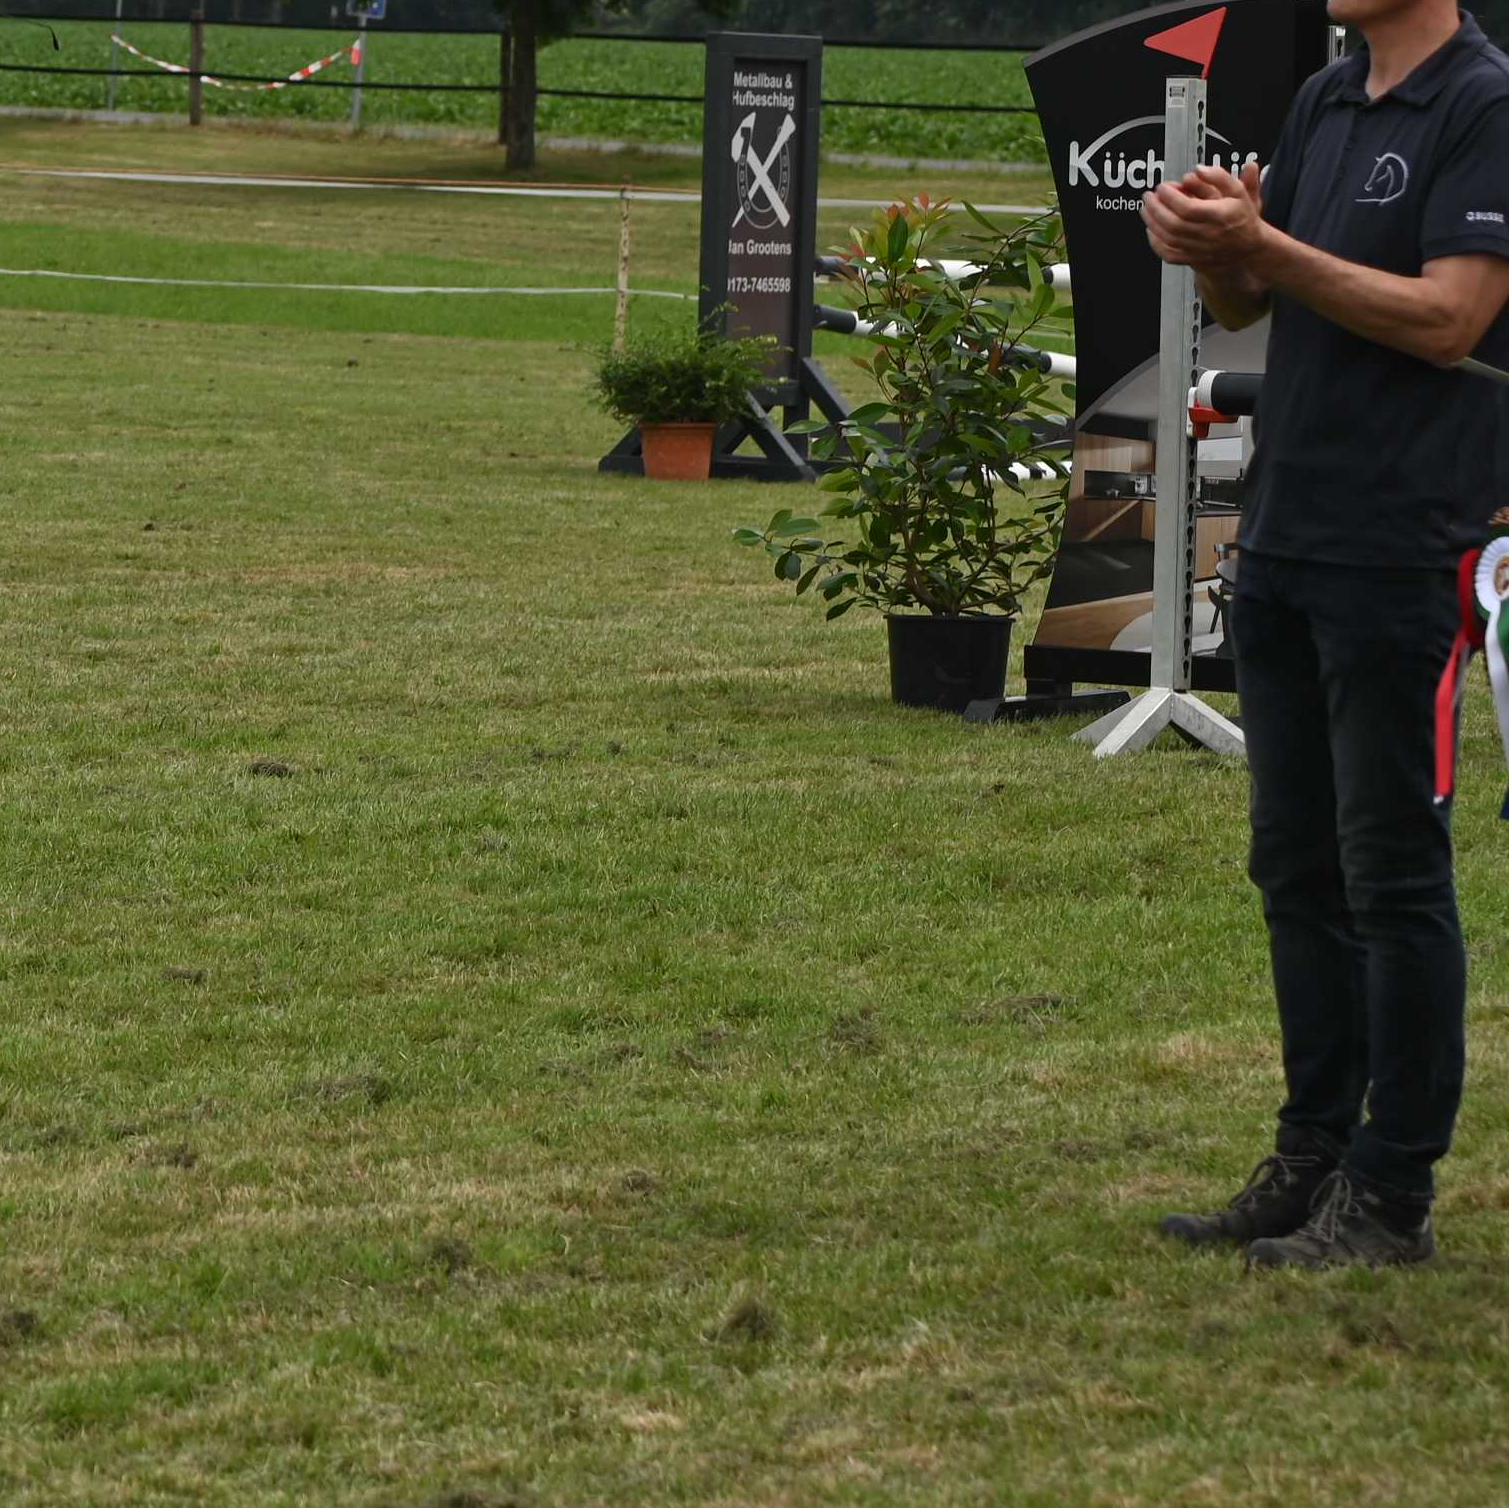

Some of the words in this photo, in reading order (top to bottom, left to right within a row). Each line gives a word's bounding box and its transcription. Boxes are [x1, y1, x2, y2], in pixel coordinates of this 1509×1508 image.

[734, 71, 782, 89] Metallbau
[784, 73, 793, 89] &
[732, 90, 795, 111] Hufbeschlag
[1096, 196, 1144, 211] kochen
[746, 239, 792, 255] Grootens
